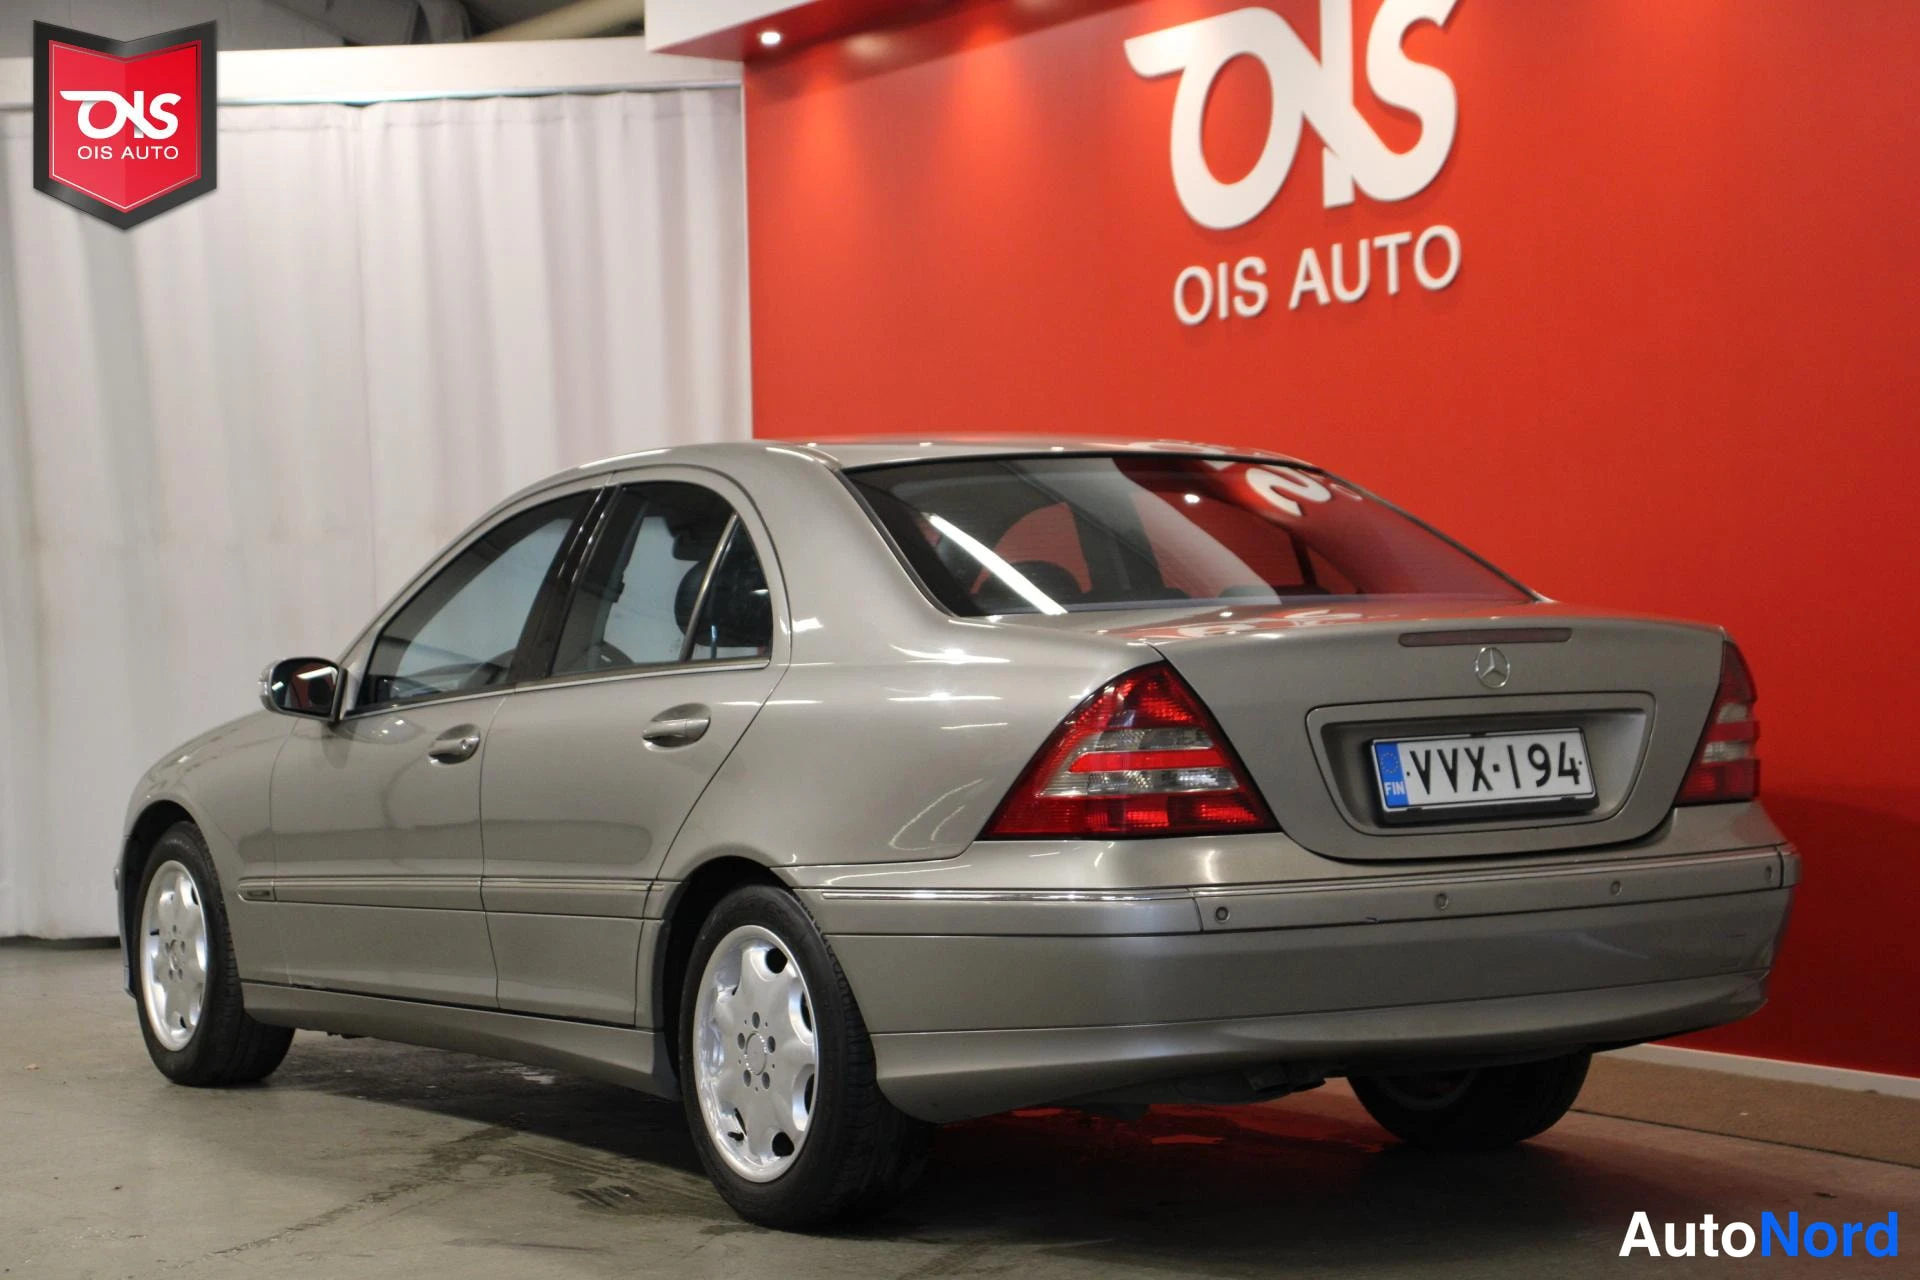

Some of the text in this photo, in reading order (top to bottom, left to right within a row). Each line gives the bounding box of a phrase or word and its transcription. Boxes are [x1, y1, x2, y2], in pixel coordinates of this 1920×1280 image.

[1173, 224, 1462, 326] OIS AUTO
[1384, 781, 1405, 796] FIN
